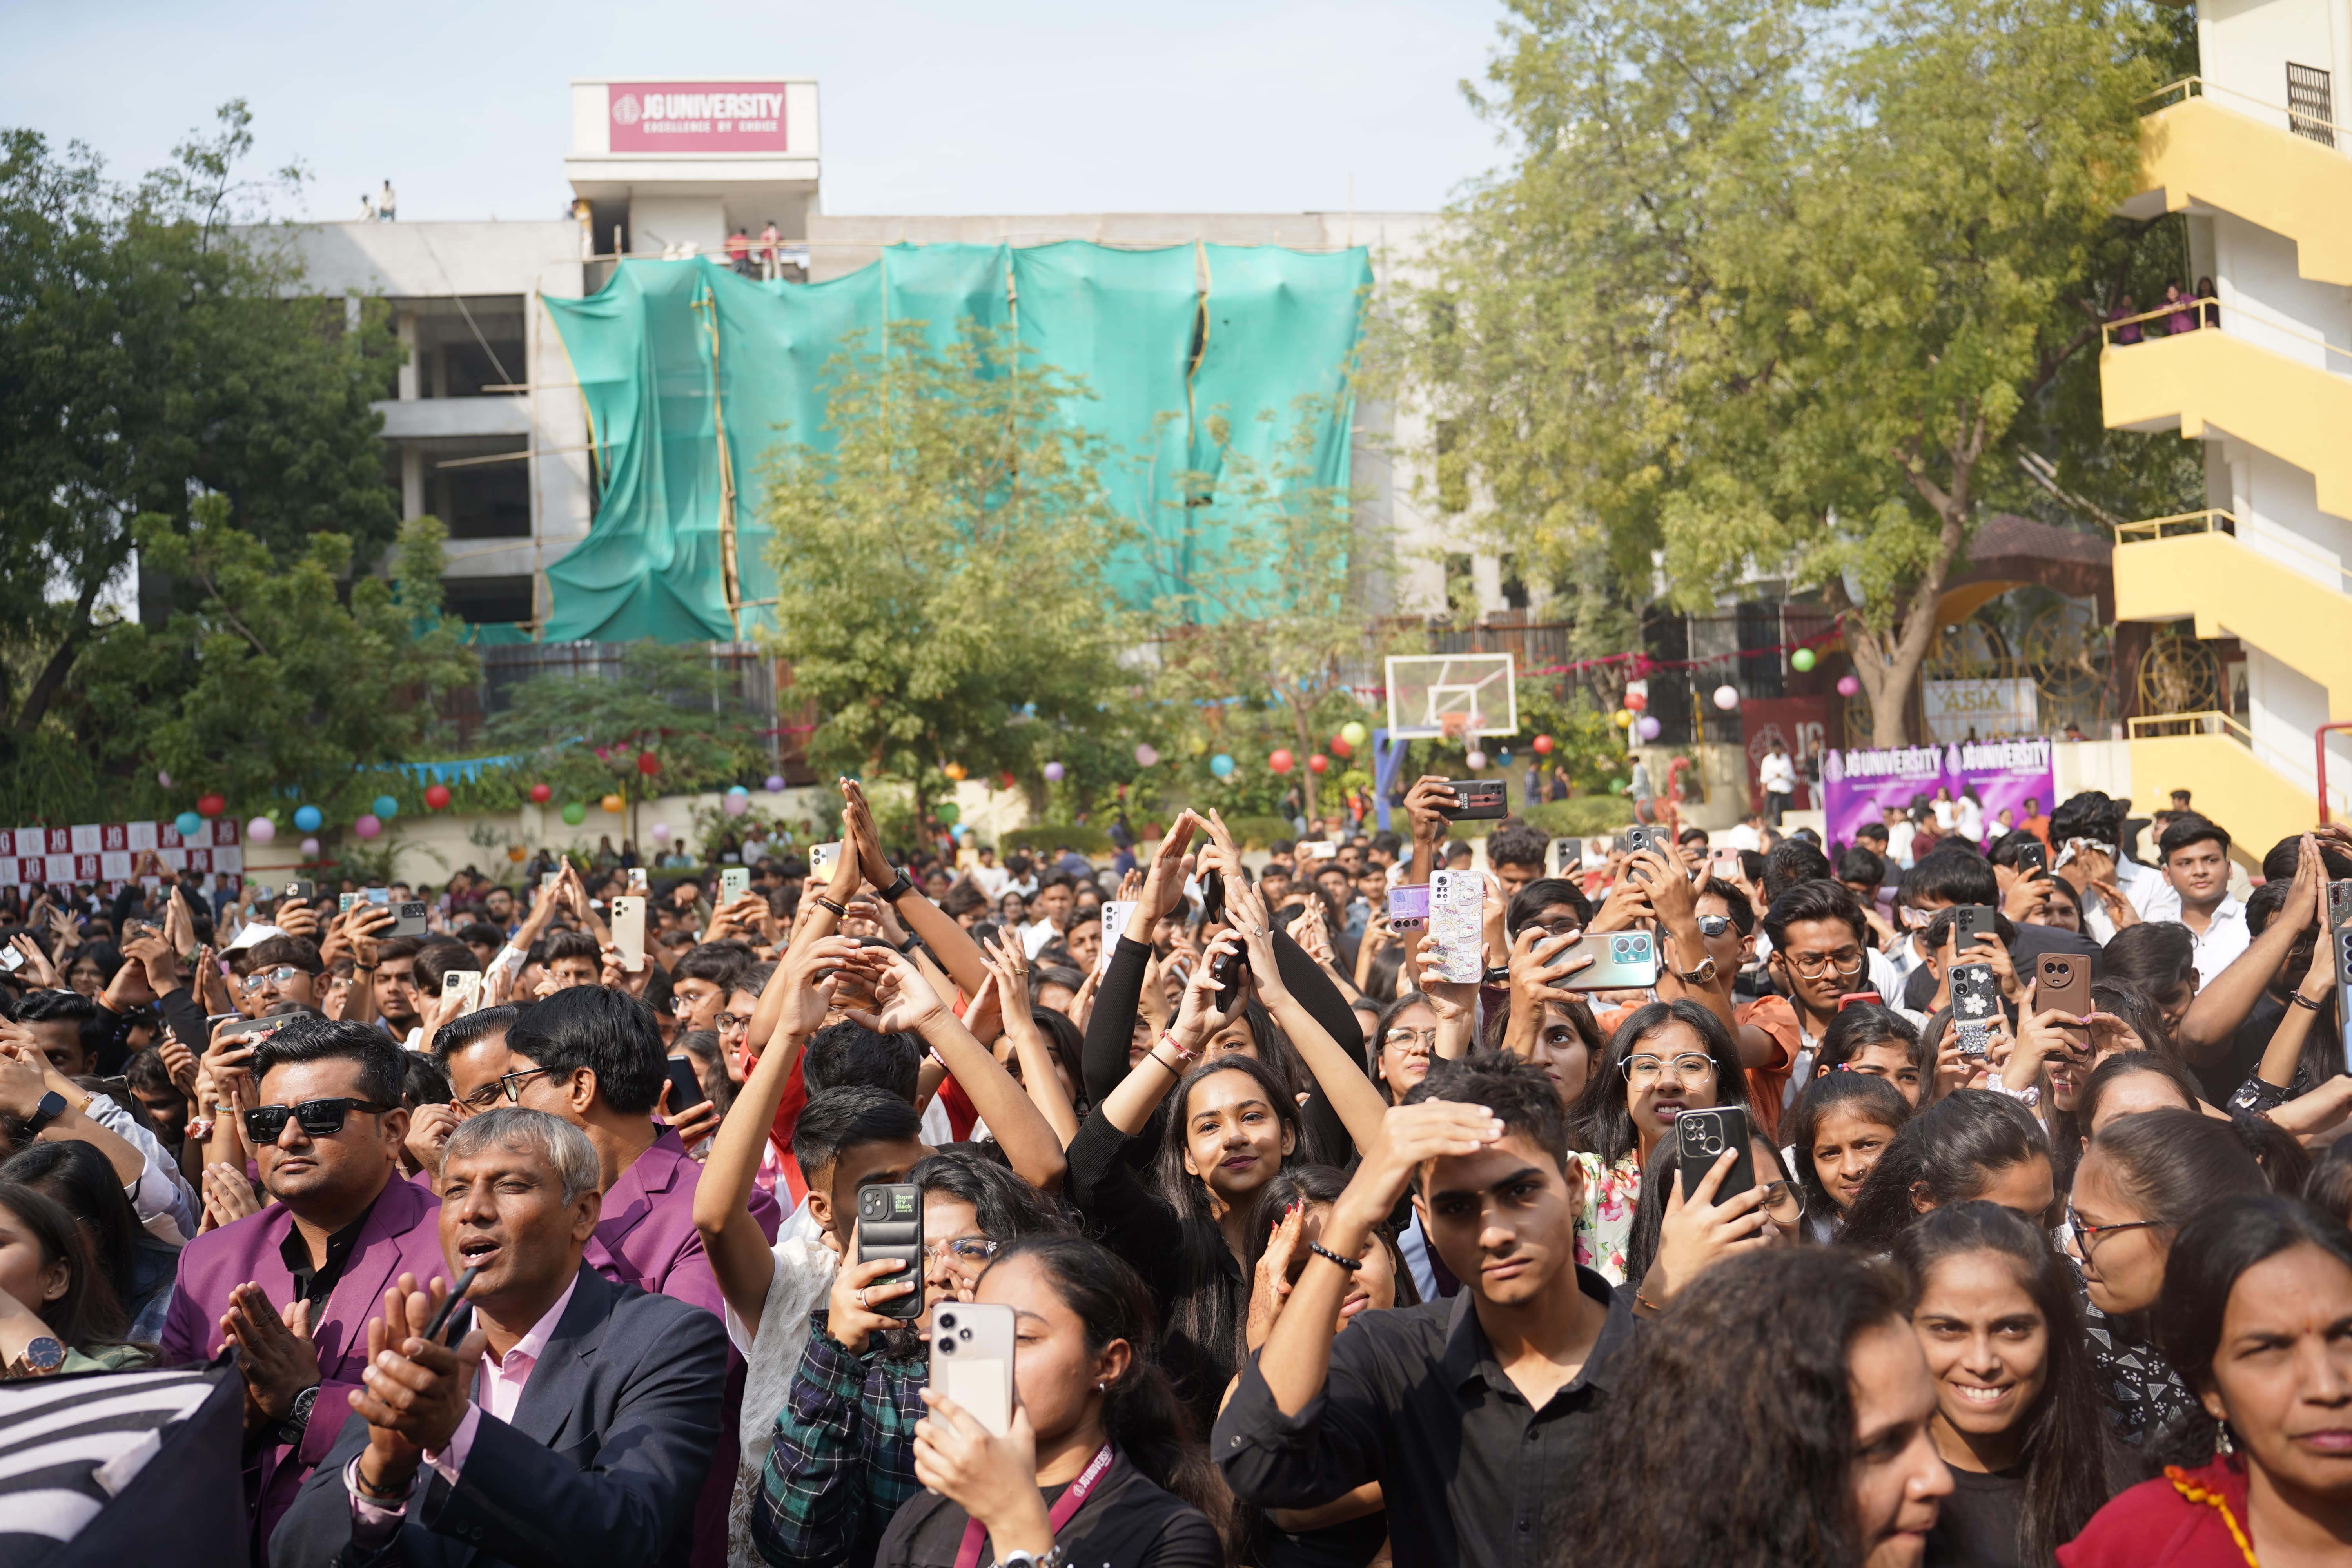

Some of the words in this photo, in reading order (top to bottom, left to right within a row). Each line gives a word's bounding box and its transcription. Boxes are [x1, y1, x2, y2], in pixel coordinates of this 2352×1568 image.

[666, 93, 783, 119] UNIVERSITY
[643, 120, 710, 134] EXCELLENCE
[717, 120, 733, 133] BY
[1944, 690, 2002, 712] ASIA
[51, 829, 67, 851] JG
[106, 826, 123, 848] JG
[24, 857, 41, 879] JG
[80, 855, 97, 877] JG
